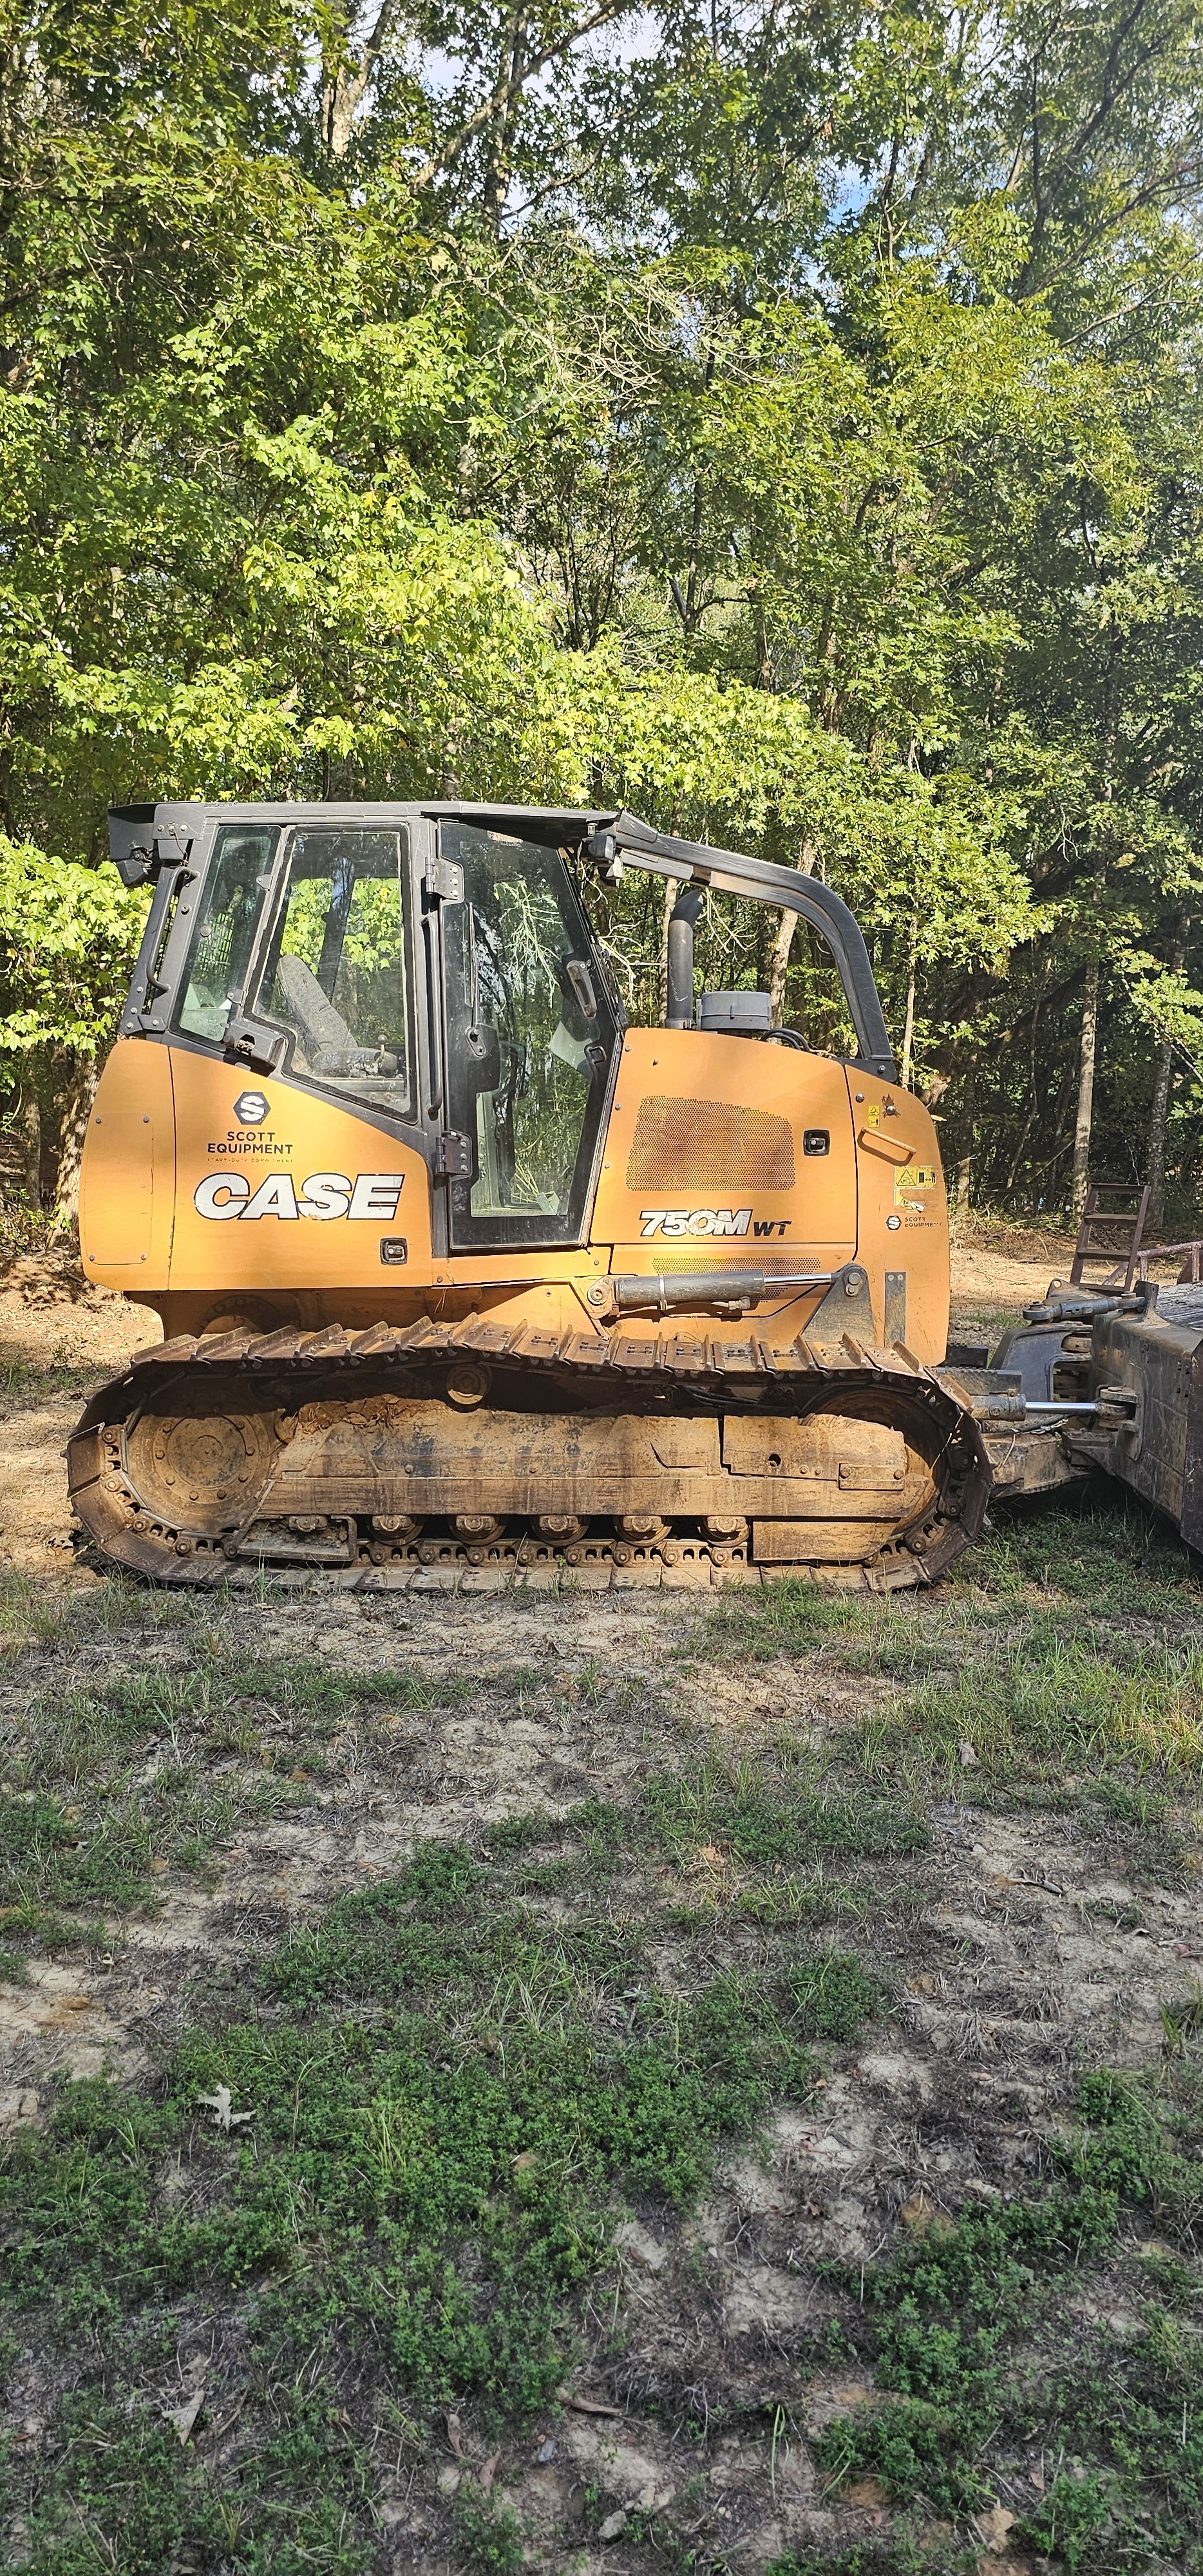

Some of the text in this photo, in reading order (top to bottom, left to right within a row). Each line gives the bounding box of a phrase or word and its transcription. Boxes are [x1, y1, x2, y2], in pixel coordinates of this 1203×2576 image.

[227, 1131, 276, 1142] SCOTT
[207, 1143, 294, 1154] EQUIPMENT
[193, 1172, 406, 1220] CASE
[639, 1209, 792, 1236] 750M WT
